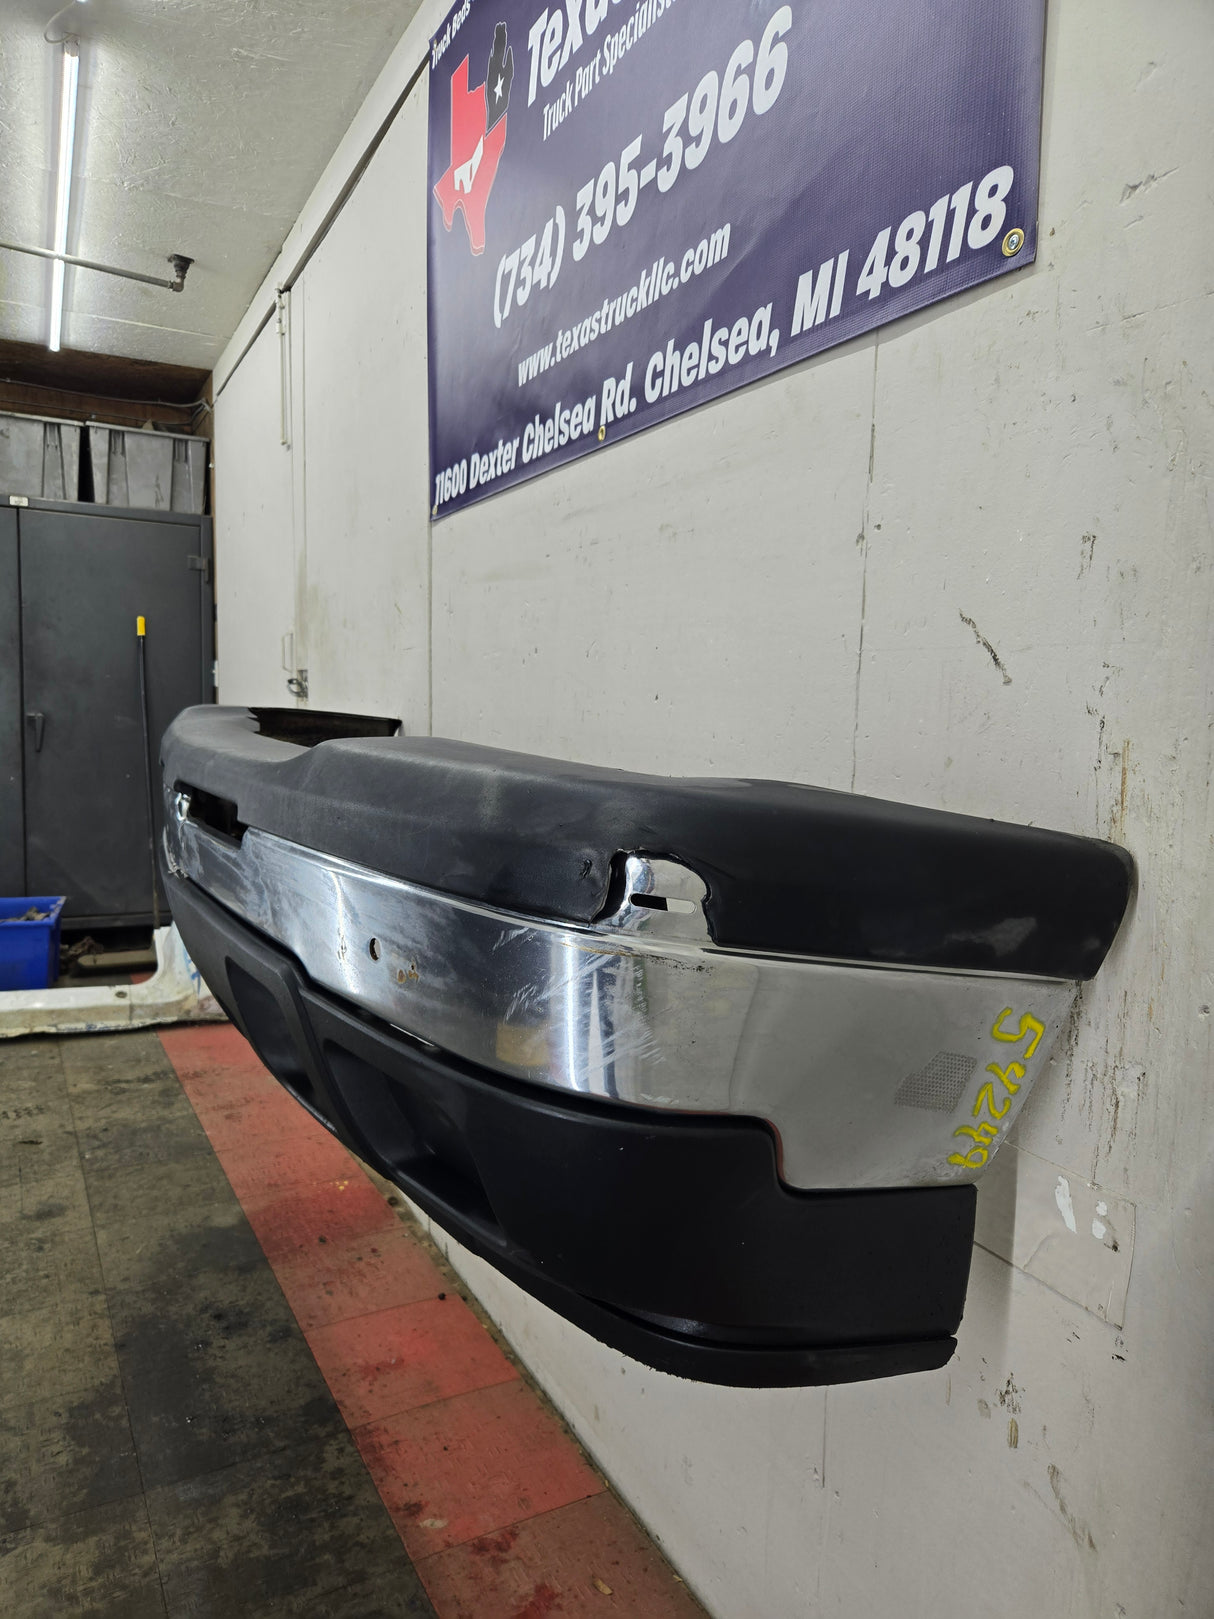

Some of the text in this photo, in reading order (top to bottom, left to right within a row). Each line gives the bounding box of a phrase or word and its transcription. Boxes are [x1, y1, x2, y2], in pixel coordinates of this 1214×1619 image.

[527, 0, 622, 107] Texa
[543, 80, 572, 141] Truck
[574, 49, 601, 106] Part
[493, 5, 793, 328] (734) 395-3966
[434, 165, 1015, 506] 11600 Dexter Chelsea Rd. Chelsea, MI 48118
[518, 223, 731, 387] www.texastruckllc.com
